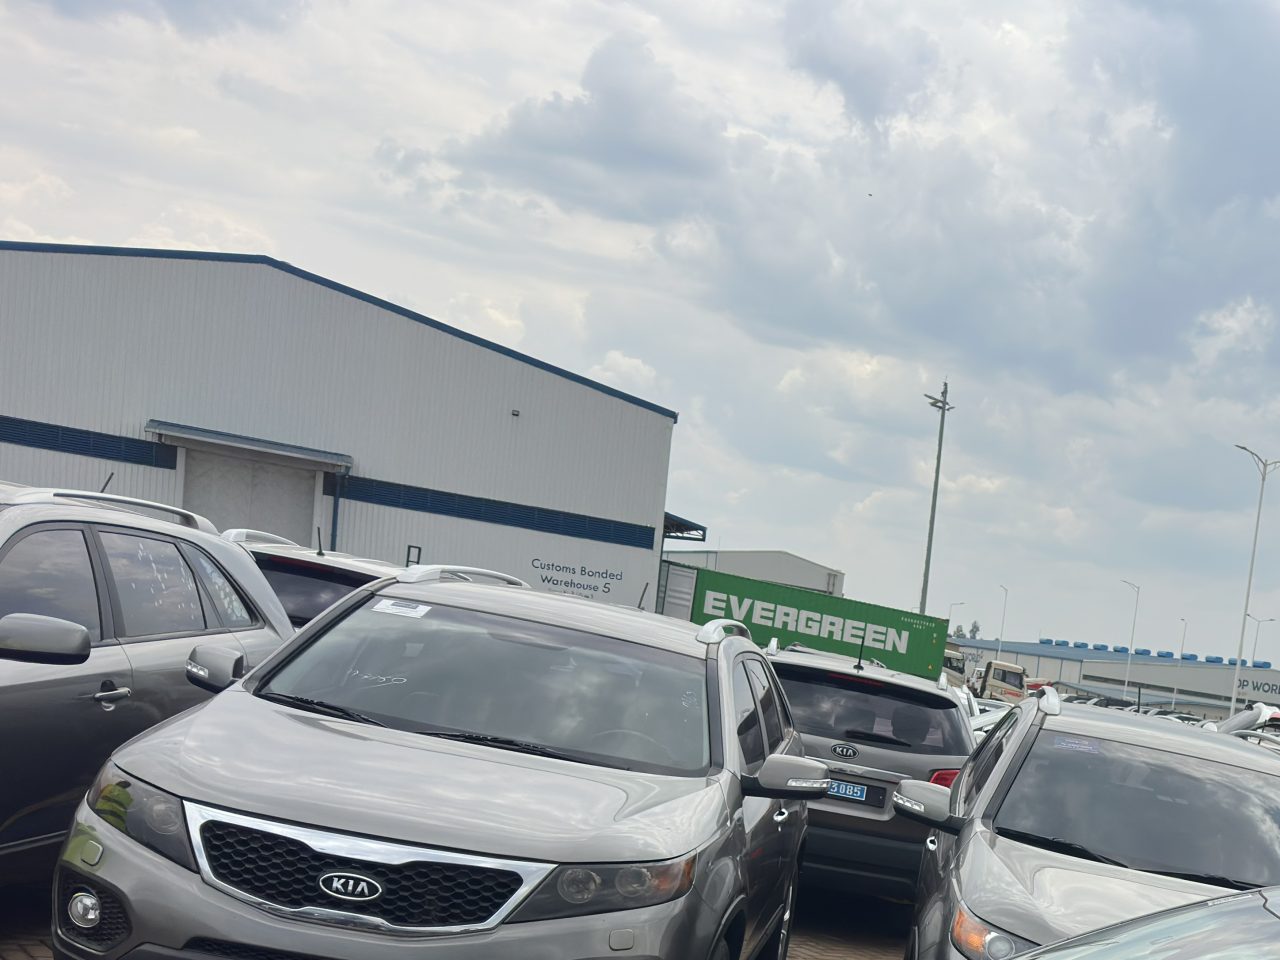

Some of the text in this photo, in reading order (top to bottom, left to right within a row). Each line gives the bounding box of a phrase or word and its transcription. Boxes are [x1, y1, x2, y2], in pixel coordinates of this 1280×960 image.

[531, 558, 623, 580] Customs Bonded
[540, 574, 611, 593] Warehouse 5
[703, 590, 910, 654] EVERGREEN
[830, 782, 861, 796] 3085
[332, 876, 369, 897] KIA
